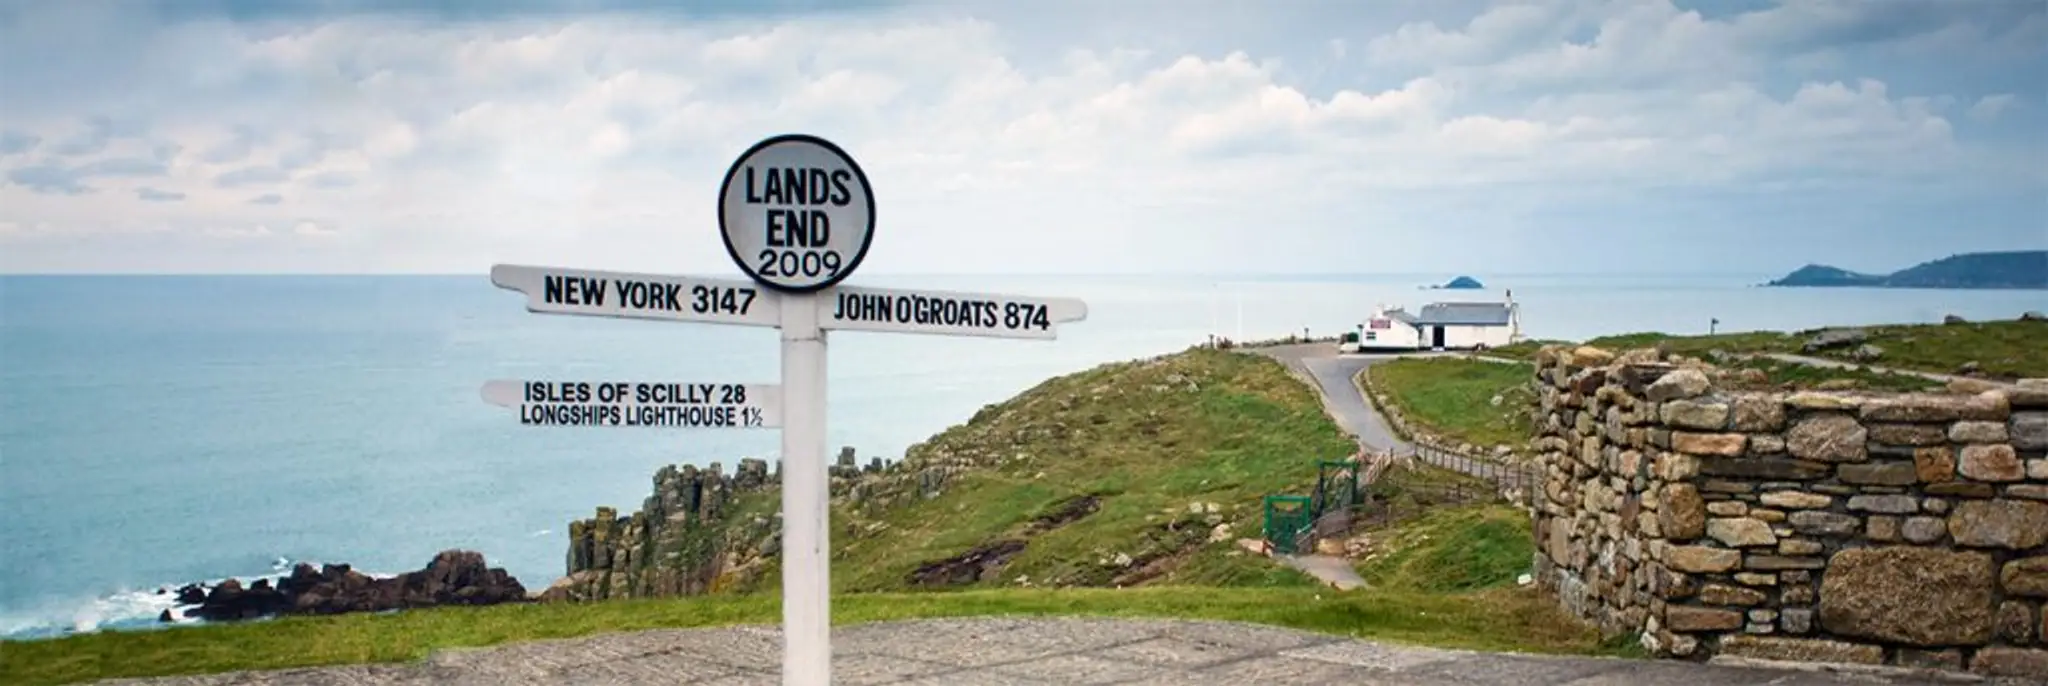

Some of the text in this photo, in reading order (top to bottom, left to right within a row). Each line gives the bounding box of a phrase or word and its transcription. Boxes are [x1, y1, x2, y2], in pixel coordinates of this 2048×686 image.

[746, 166, 851, 206] LANDS
[766, 209, 830, 247] END
[759, 249, 841, 277] 2009
[544, 275, 757, 315] NEW YORK 3147
[834, 293, 1051, 331] JOHN O'GROATS 874
[525, 382, 746, 404] ISLES OF SCILLY 28
[521, 404, 621, 425] LONGSHIPS
[626, 406, 736, 426] LIGHTHOUSE
